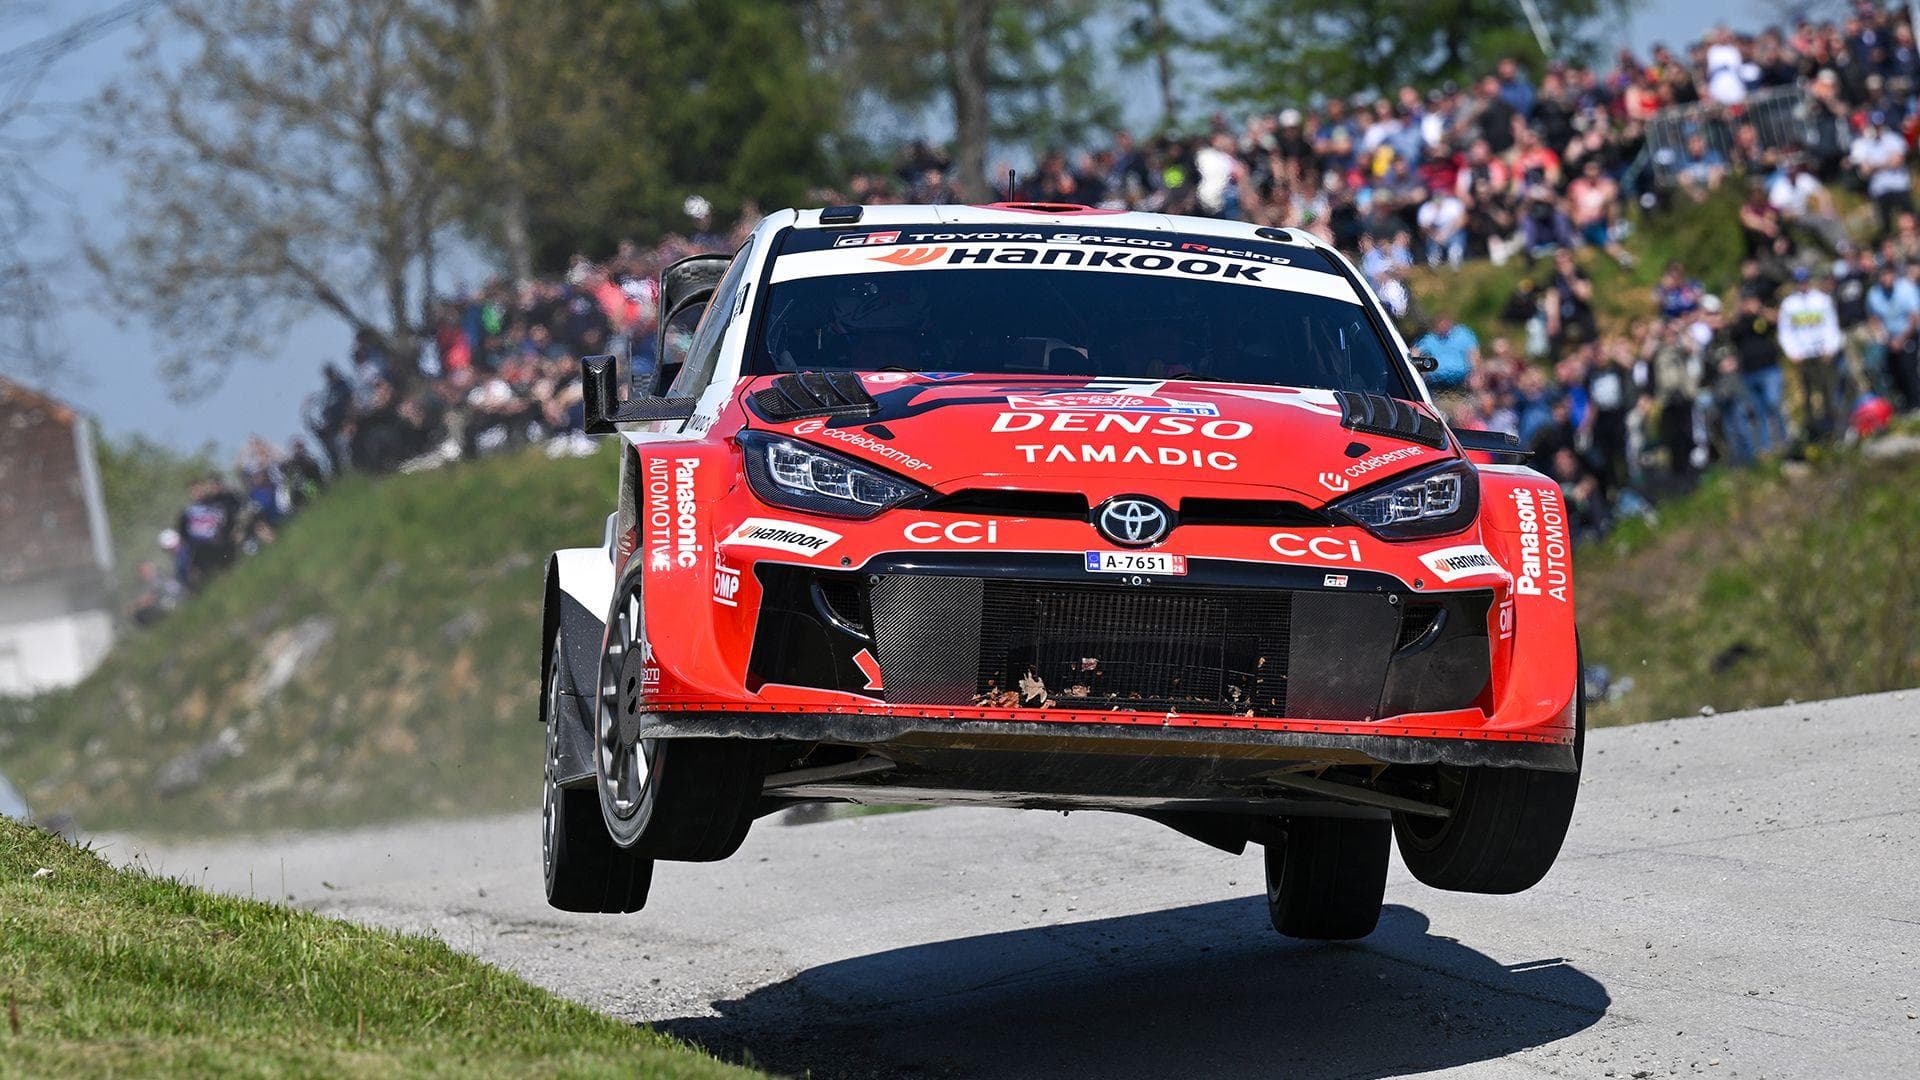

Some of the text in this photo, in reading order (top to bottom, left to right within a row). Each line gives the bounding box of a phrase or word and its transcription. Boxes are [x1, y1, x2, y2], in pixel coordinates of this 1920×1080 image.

[835, 232, 900, 247] GR
[909, 233, 1291, 265] TOYOTA GAZOO Racing
[990, 412, 1254, 440] DENSO
[822, 426, 929, 471] codebeamer
[1015, 444, 1238, 470] TAMADIC
[1345, 445, 1425, 478] codebeamer
[650, 458, 671, 572] AUTOMOTIVE
[675, 457, 703, 569] Panasonic
[1508, 488, 1541, 596] Panasonic
[1537, 488, 1567, 603] AUTOMOTIVE
[1106, 555, 1165, 570] A-7651
[713, 570, 740, 600] OMP
